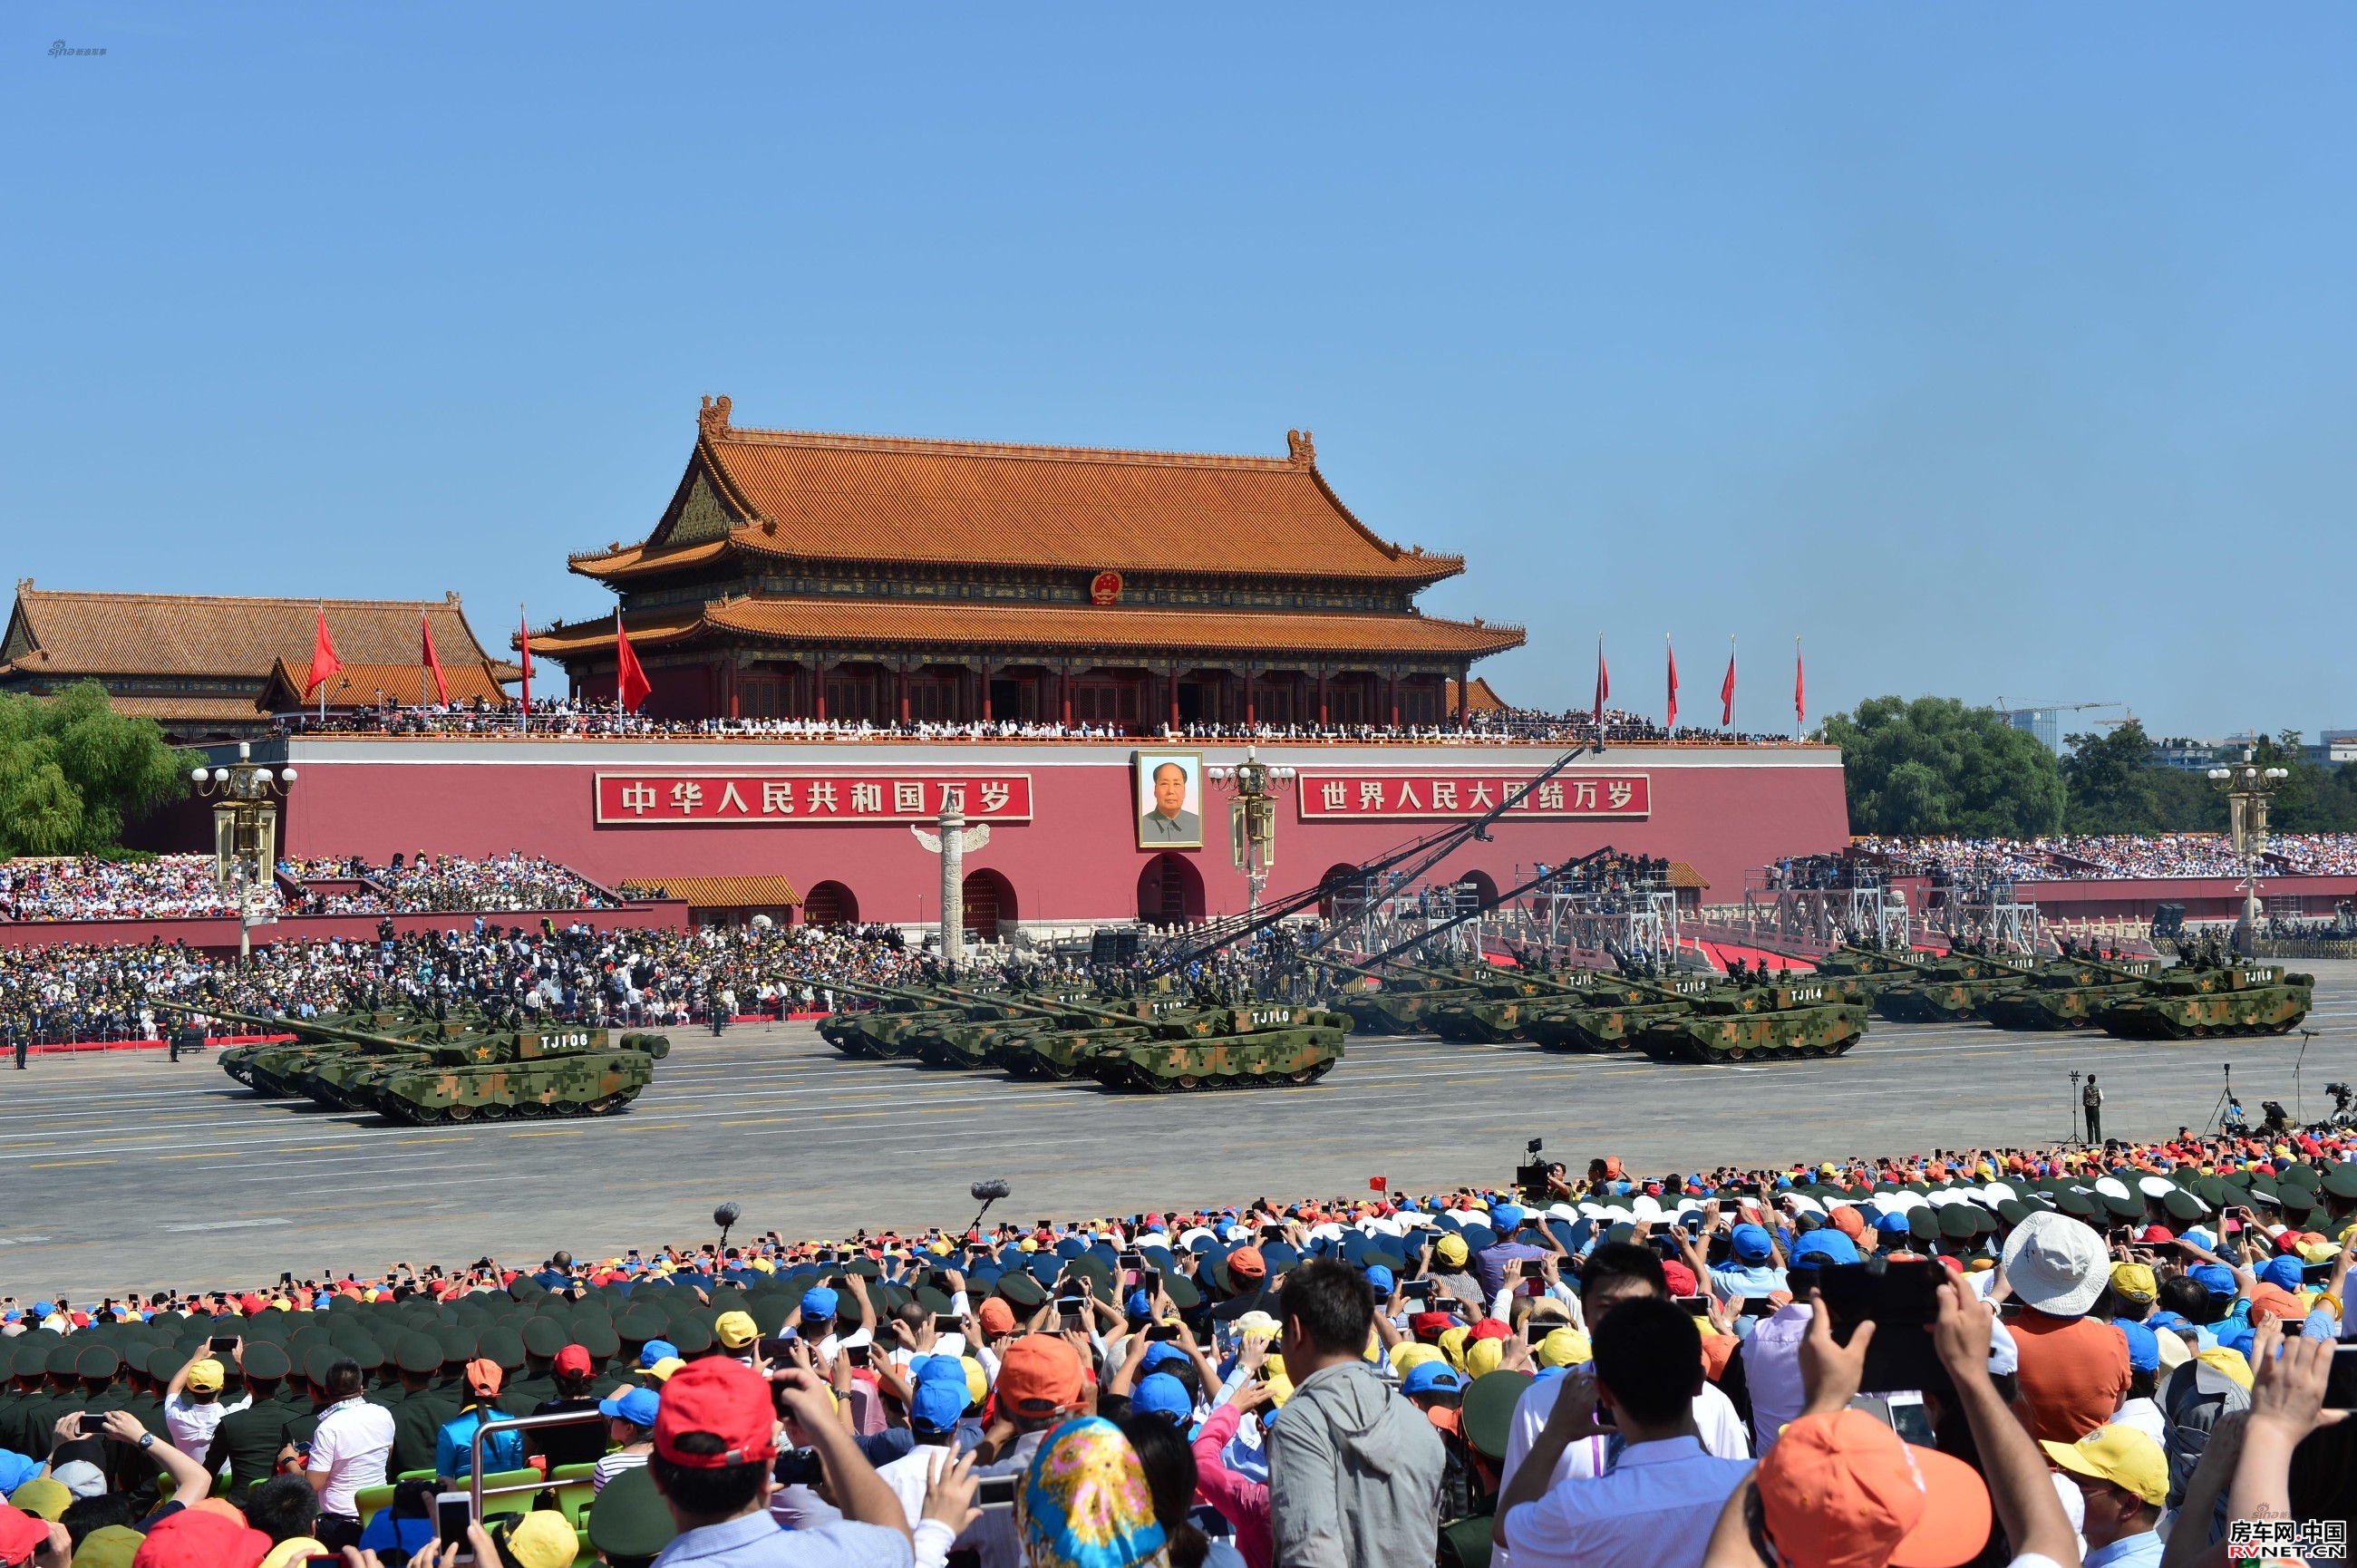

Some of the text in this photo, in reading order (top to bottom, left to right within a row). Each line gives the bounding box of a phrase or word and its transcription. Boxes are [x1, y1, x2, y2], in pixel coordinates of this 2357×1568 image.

[622, 780, 1011, 814] 中华人民共和国万岁
[1321, 781, 1633, 810] 世界人民大团结万岁
[2245, 970, 2272, 982] TJ118
[1675, 981, 1706, 993] TJ113
[1790, 988, 1822, 1002] TJ114
[1252, 1011, 1289, 1024] TJ110
[540, 1033, 588, 1049] TJ106
